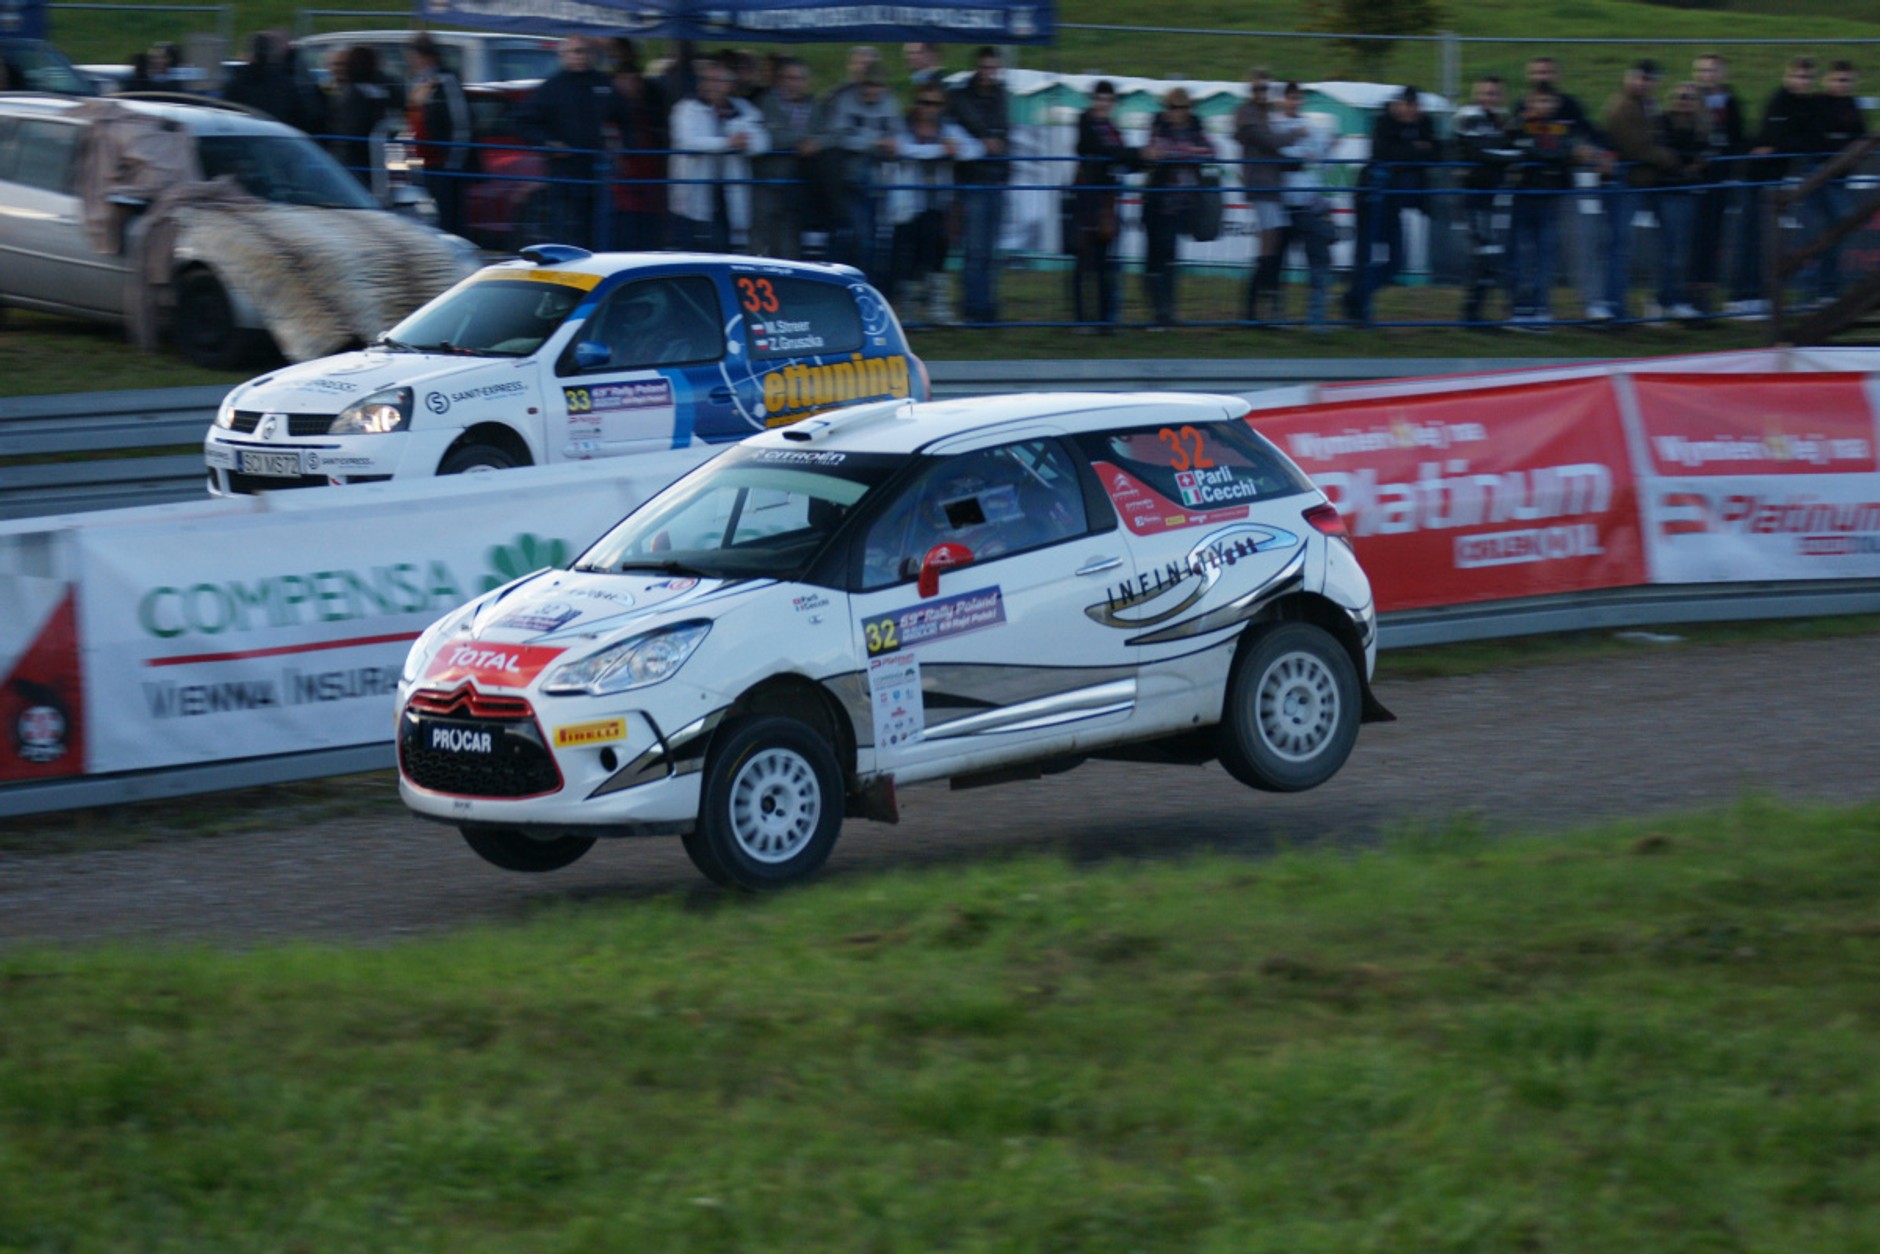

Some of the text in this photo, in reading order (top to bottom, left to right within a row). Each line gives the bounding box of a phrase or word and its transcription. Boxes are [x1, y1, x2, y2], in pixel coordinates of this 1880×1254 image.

[737, 278, 779, 312] 33
[566, 389, 592, 411] 33
[1158, 425, 1214, 471] 32
[1195, 465, 1233, 486] Parli
[1202, 479, 1257, 502] Cecchi
[136, 560, 467, 638] COMPENSA
[955, 592, 998, 615] Poland
[866, 619, 898, 651] 32
[449, 647, 520, 672] TOTAL
[560, 722, 619, 744] PIRELLI
